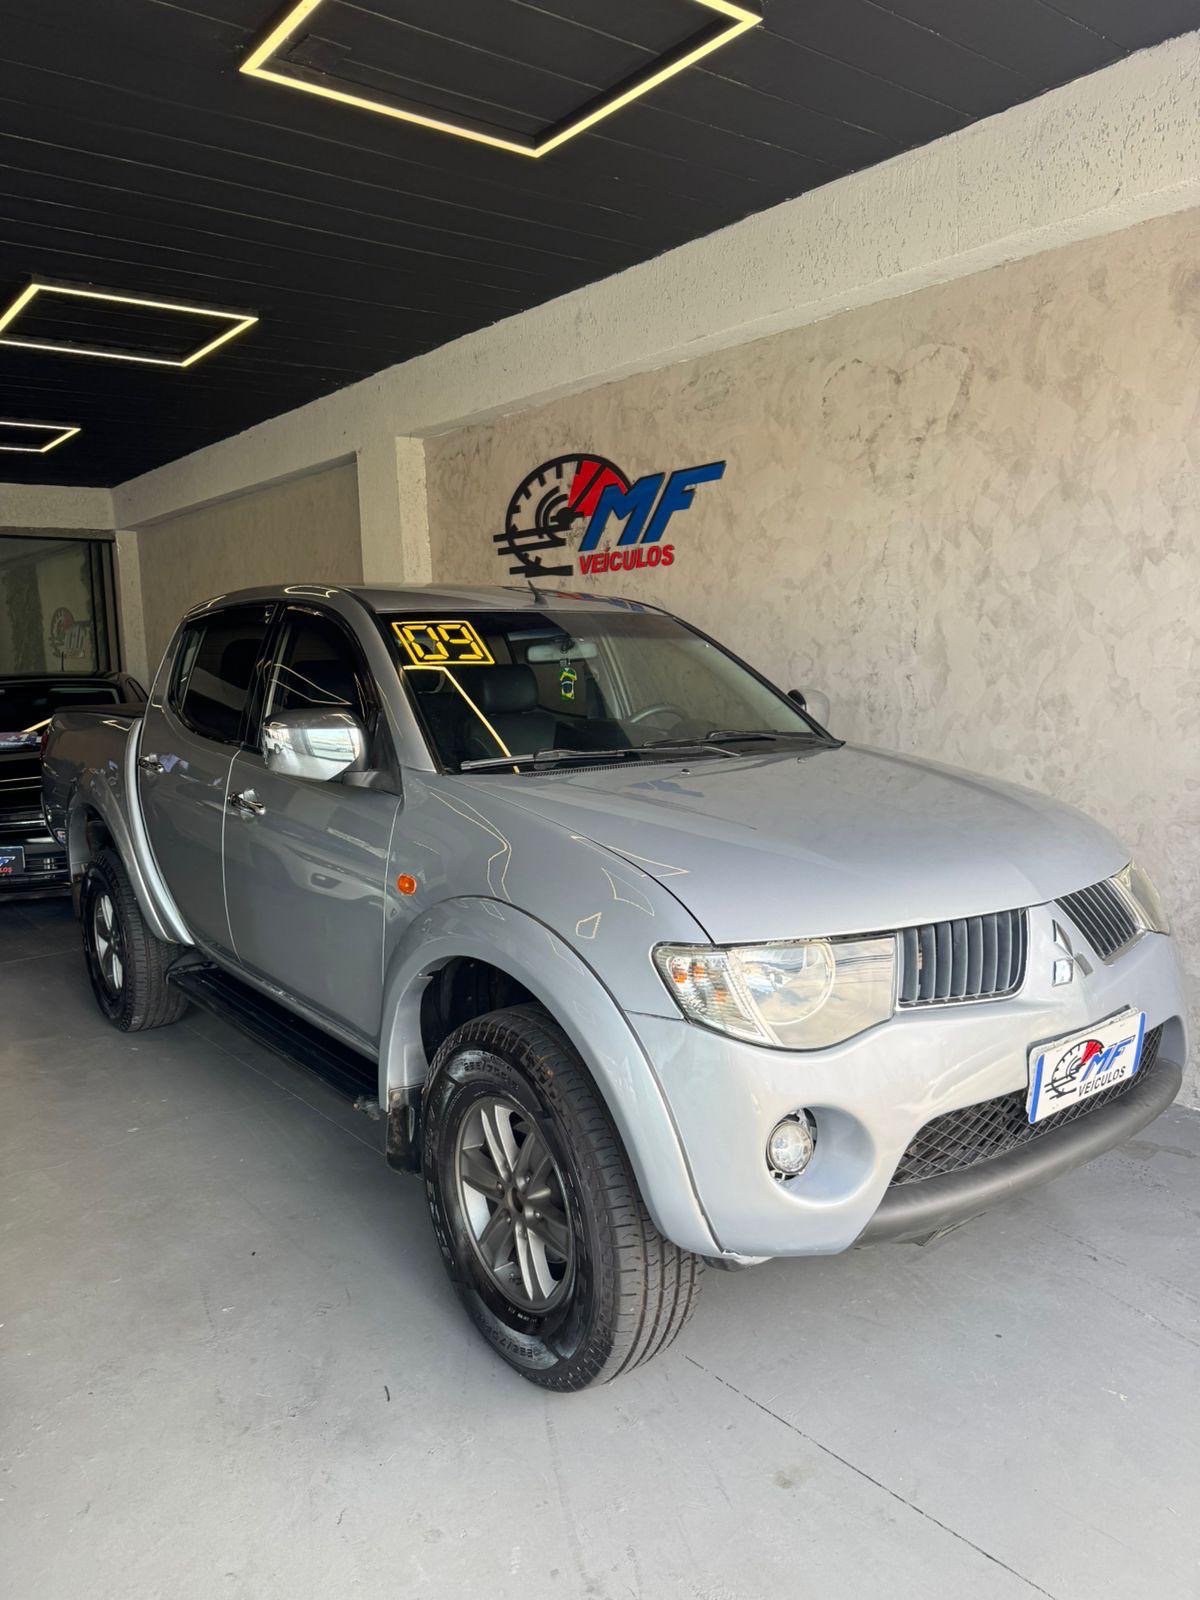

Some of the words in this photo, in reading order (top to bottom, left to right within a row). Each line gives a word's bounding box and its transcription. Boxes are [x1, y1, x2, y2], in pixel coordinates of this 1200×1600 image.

[578, 460, 726, 552] MF
[578, 544, 675, 575] VEÍCULOS
[402, 624, 484, 660] 09
[1080, 1035, 1136, 1082] MF
